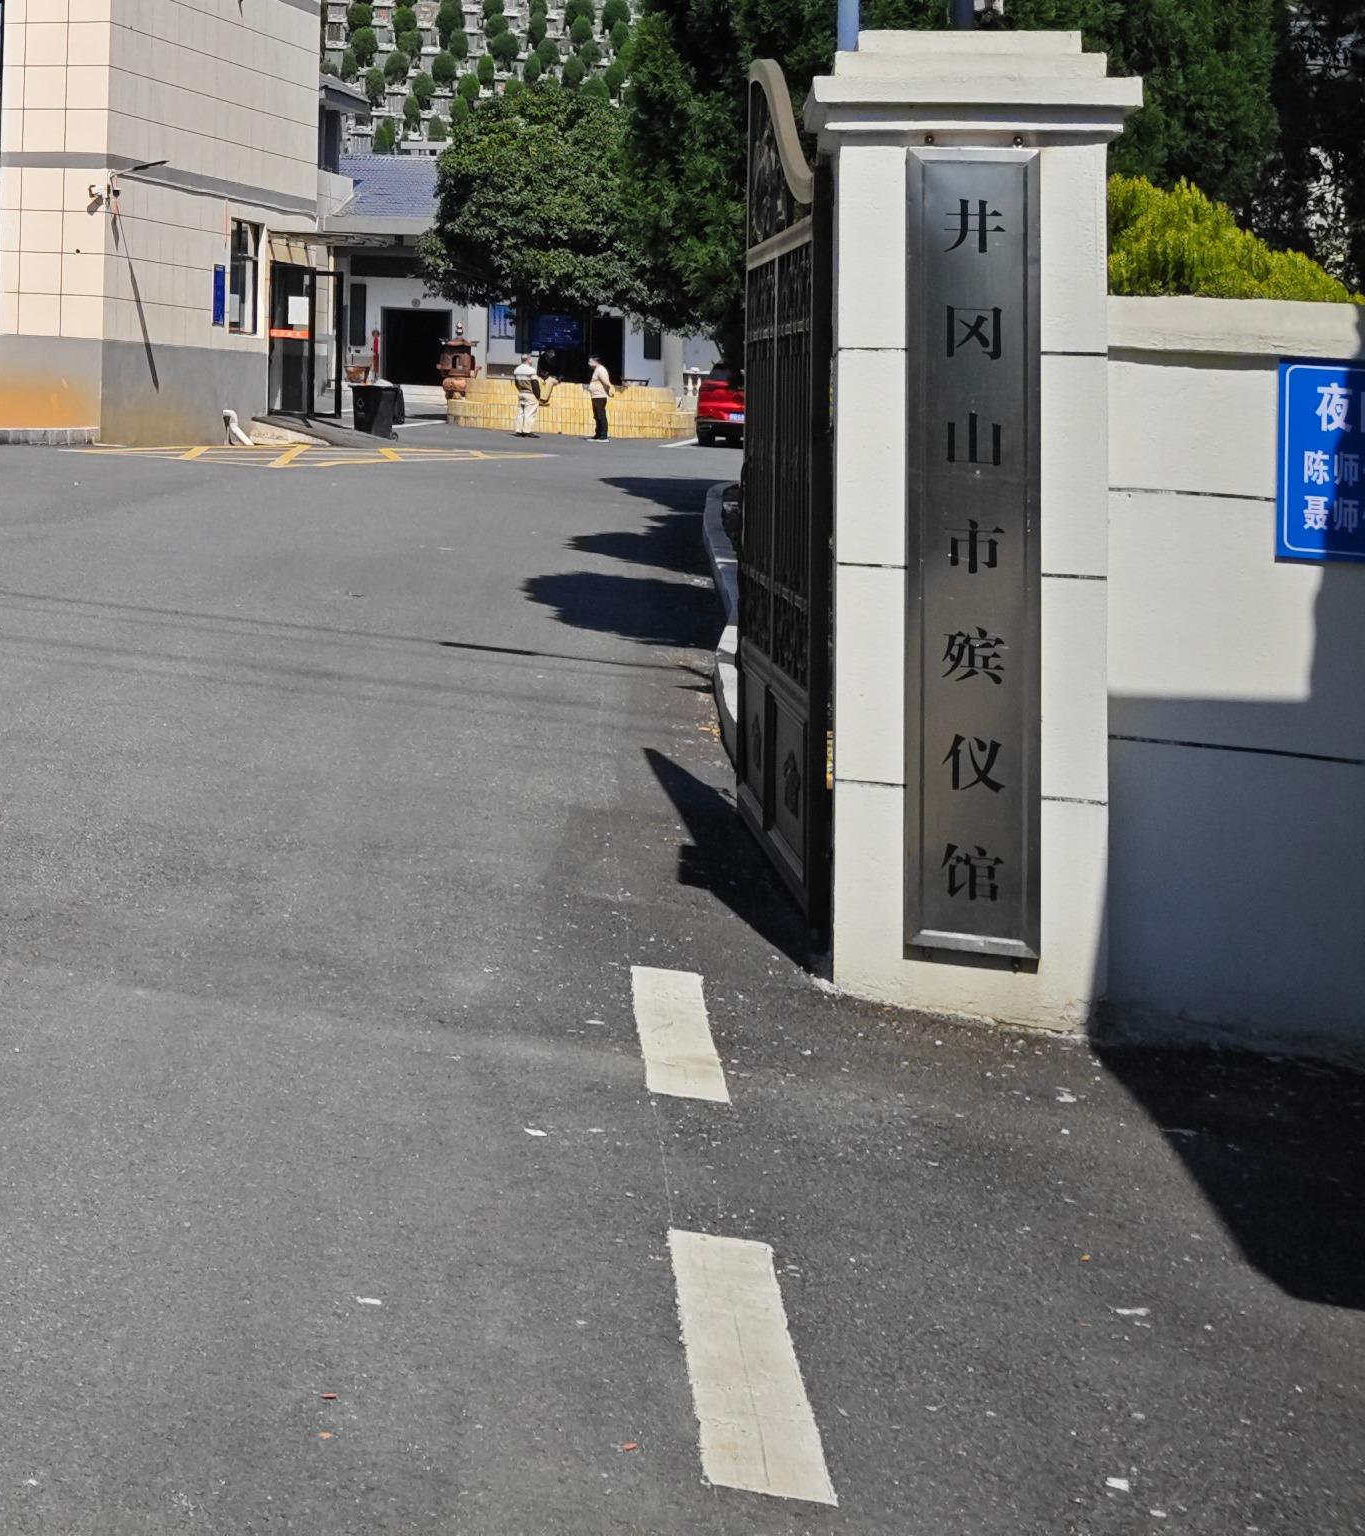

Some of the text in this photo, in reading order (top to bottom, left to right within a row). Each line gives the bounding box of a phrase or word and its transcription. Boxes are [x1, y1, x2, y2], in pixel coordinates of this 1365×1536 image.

[1315, 382, 1365, 432] 夜
[1303, 449, 1365, 486] 陈师
[1303, 495, 1365, 532] 聂师
[942, 197, 1006, 903] 井冈山市殡仪馆
